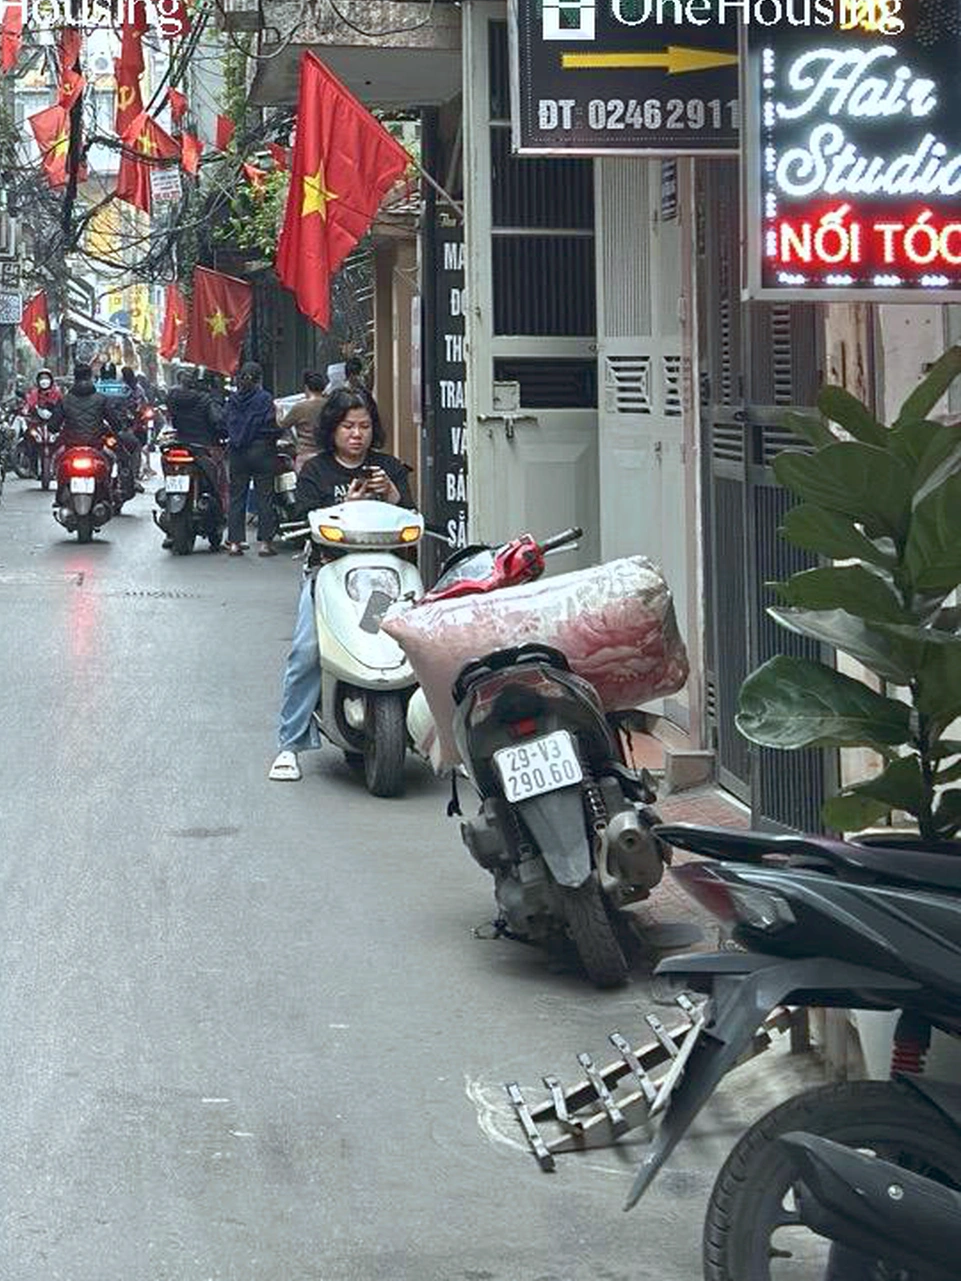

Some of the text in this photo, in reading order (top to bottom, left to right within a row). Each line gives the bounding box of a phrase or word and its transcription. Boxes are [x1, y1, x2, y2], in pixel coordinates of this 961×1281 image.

[777, 45, 937, 119] Hair
[781, 204, 860, 263] NỐI
[444, 242, 465, 271] MA
[444, 334, 464, 363] TH
[440, 380, 465, 410] TRA
[446, 469, 466, 502] BÁ
[507, 740, 561, 771] 29-V3
[508, 759, 575, 797] 290.60
